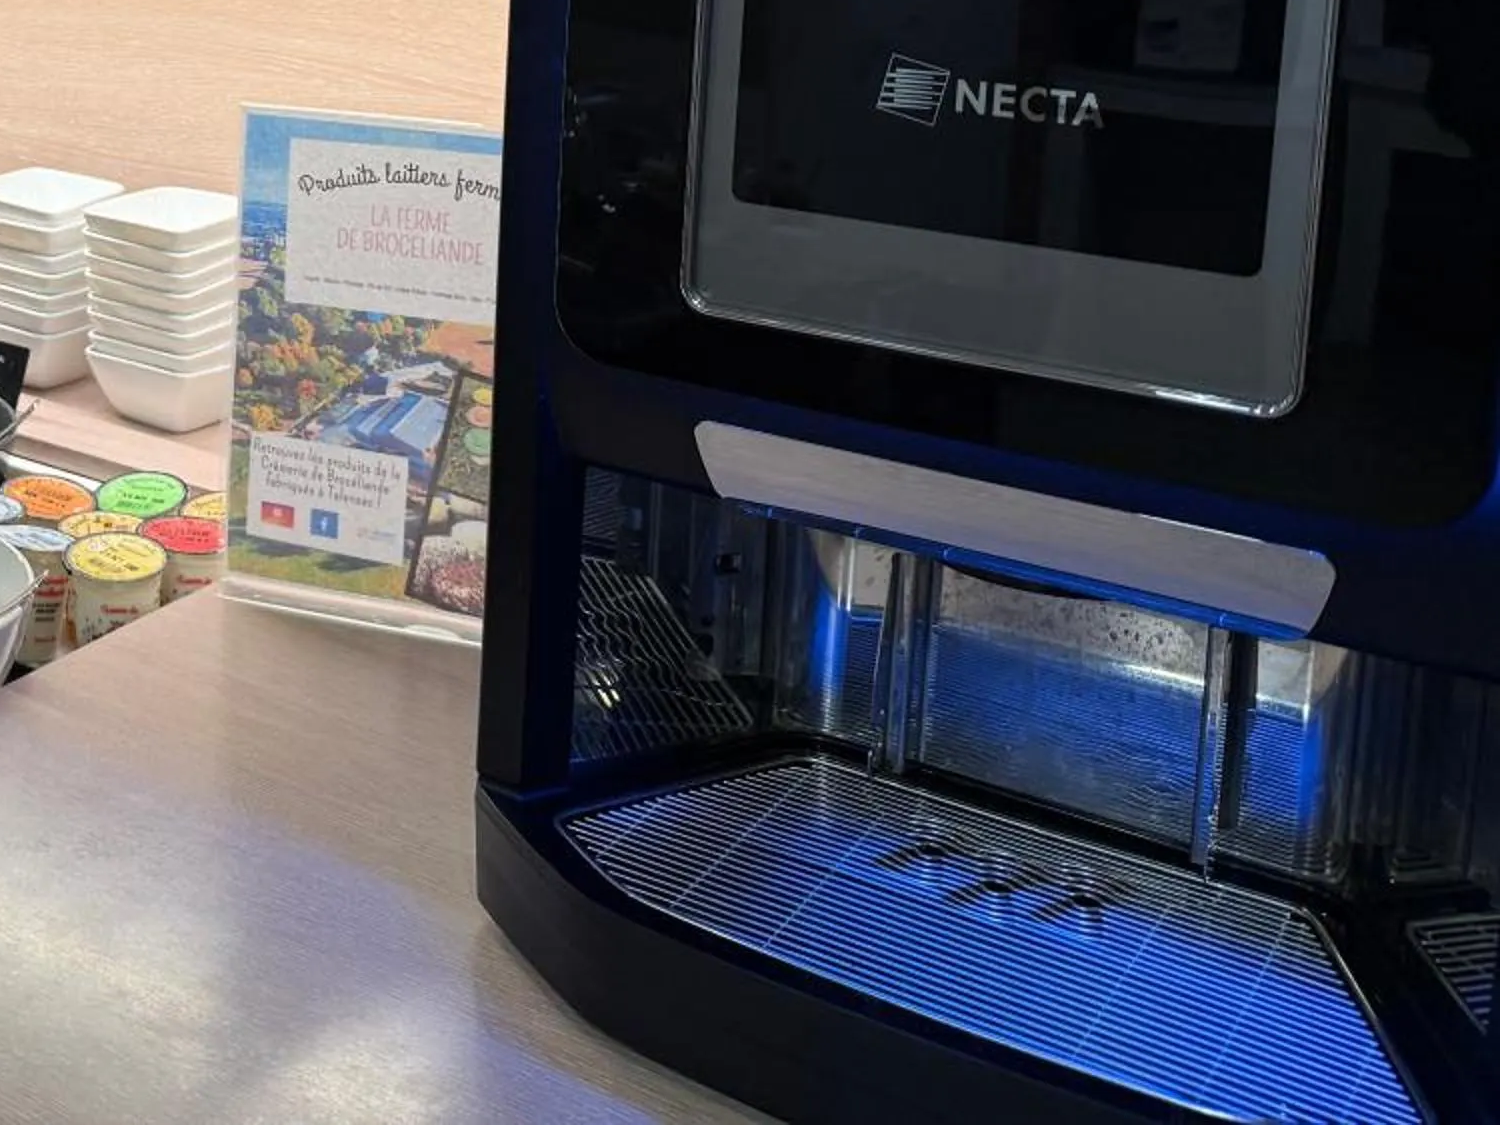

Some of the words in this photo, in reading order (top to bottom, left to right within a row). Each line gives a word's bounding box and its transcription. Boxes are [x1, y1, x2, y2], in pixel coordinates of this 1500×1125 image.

[953, 77, 1105, 130] NECTA
[297, 162, 382, 197] Produits
[385, 161, 452, 188] laitiers
[370, 203, 391, 228] LA
[396, 206, 452, 236] FERME
[336, 227, 358, 251] DE
